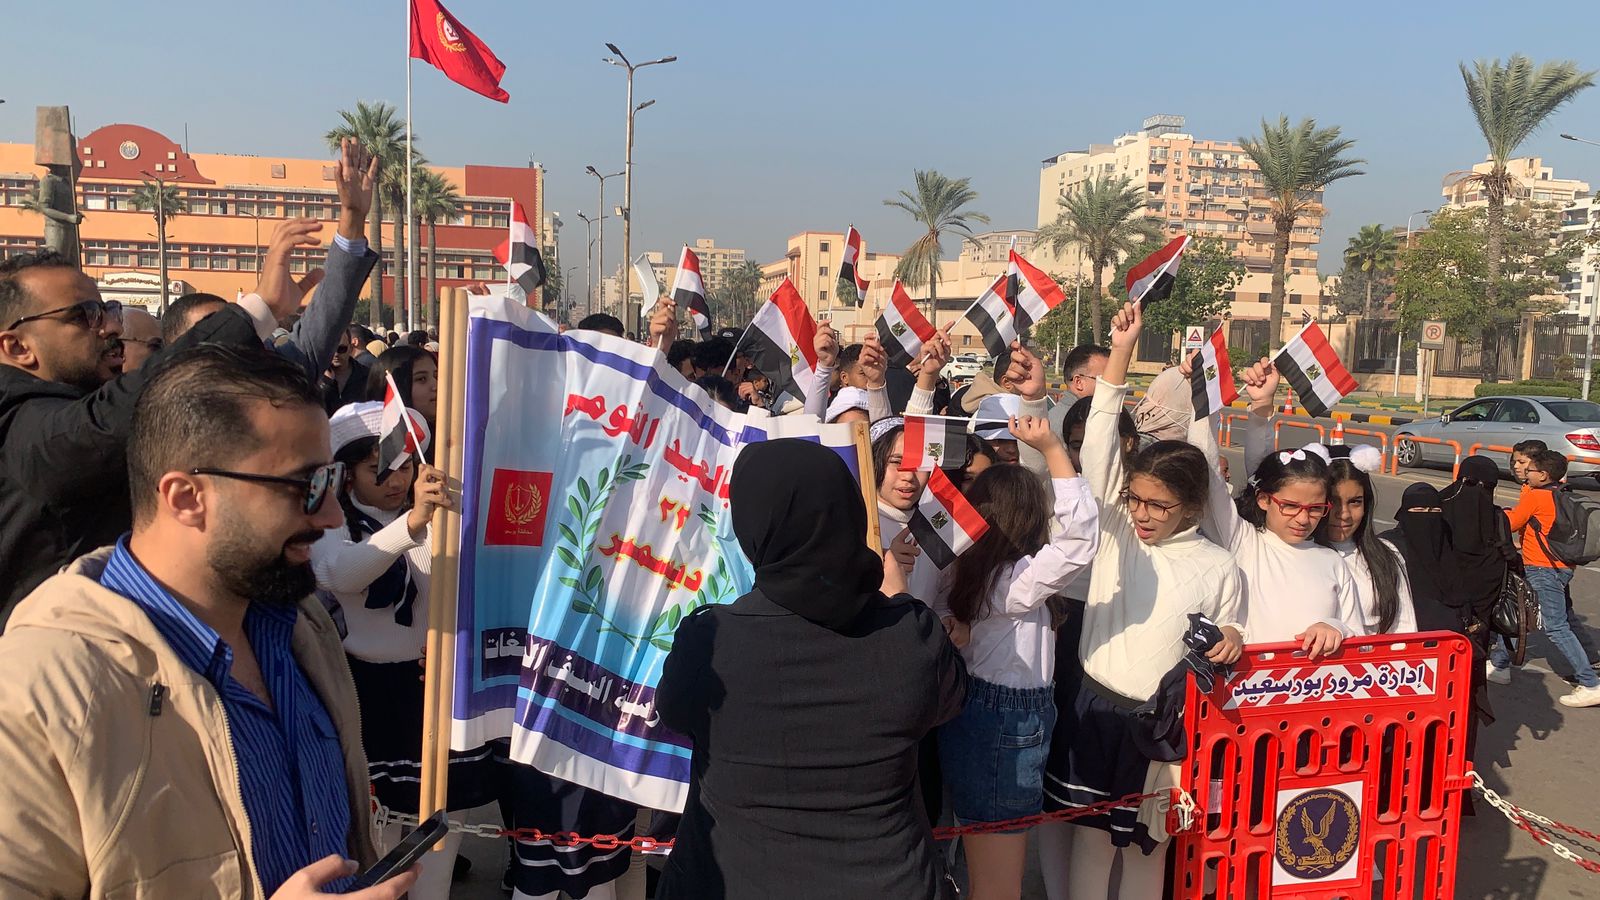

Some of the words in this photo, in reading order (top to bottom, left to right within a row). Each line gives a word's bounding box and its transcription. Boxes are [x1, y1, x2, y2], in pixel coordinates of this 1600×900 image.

[564, 393, 660, 449] القوم
[598, 533, 703, 592] ديسمبر
[1233, 675, 1322, 701] بورسعيد
[1325, 673, 1373, 695] مرور
[1378, 665, 1425, 690] إدارة
